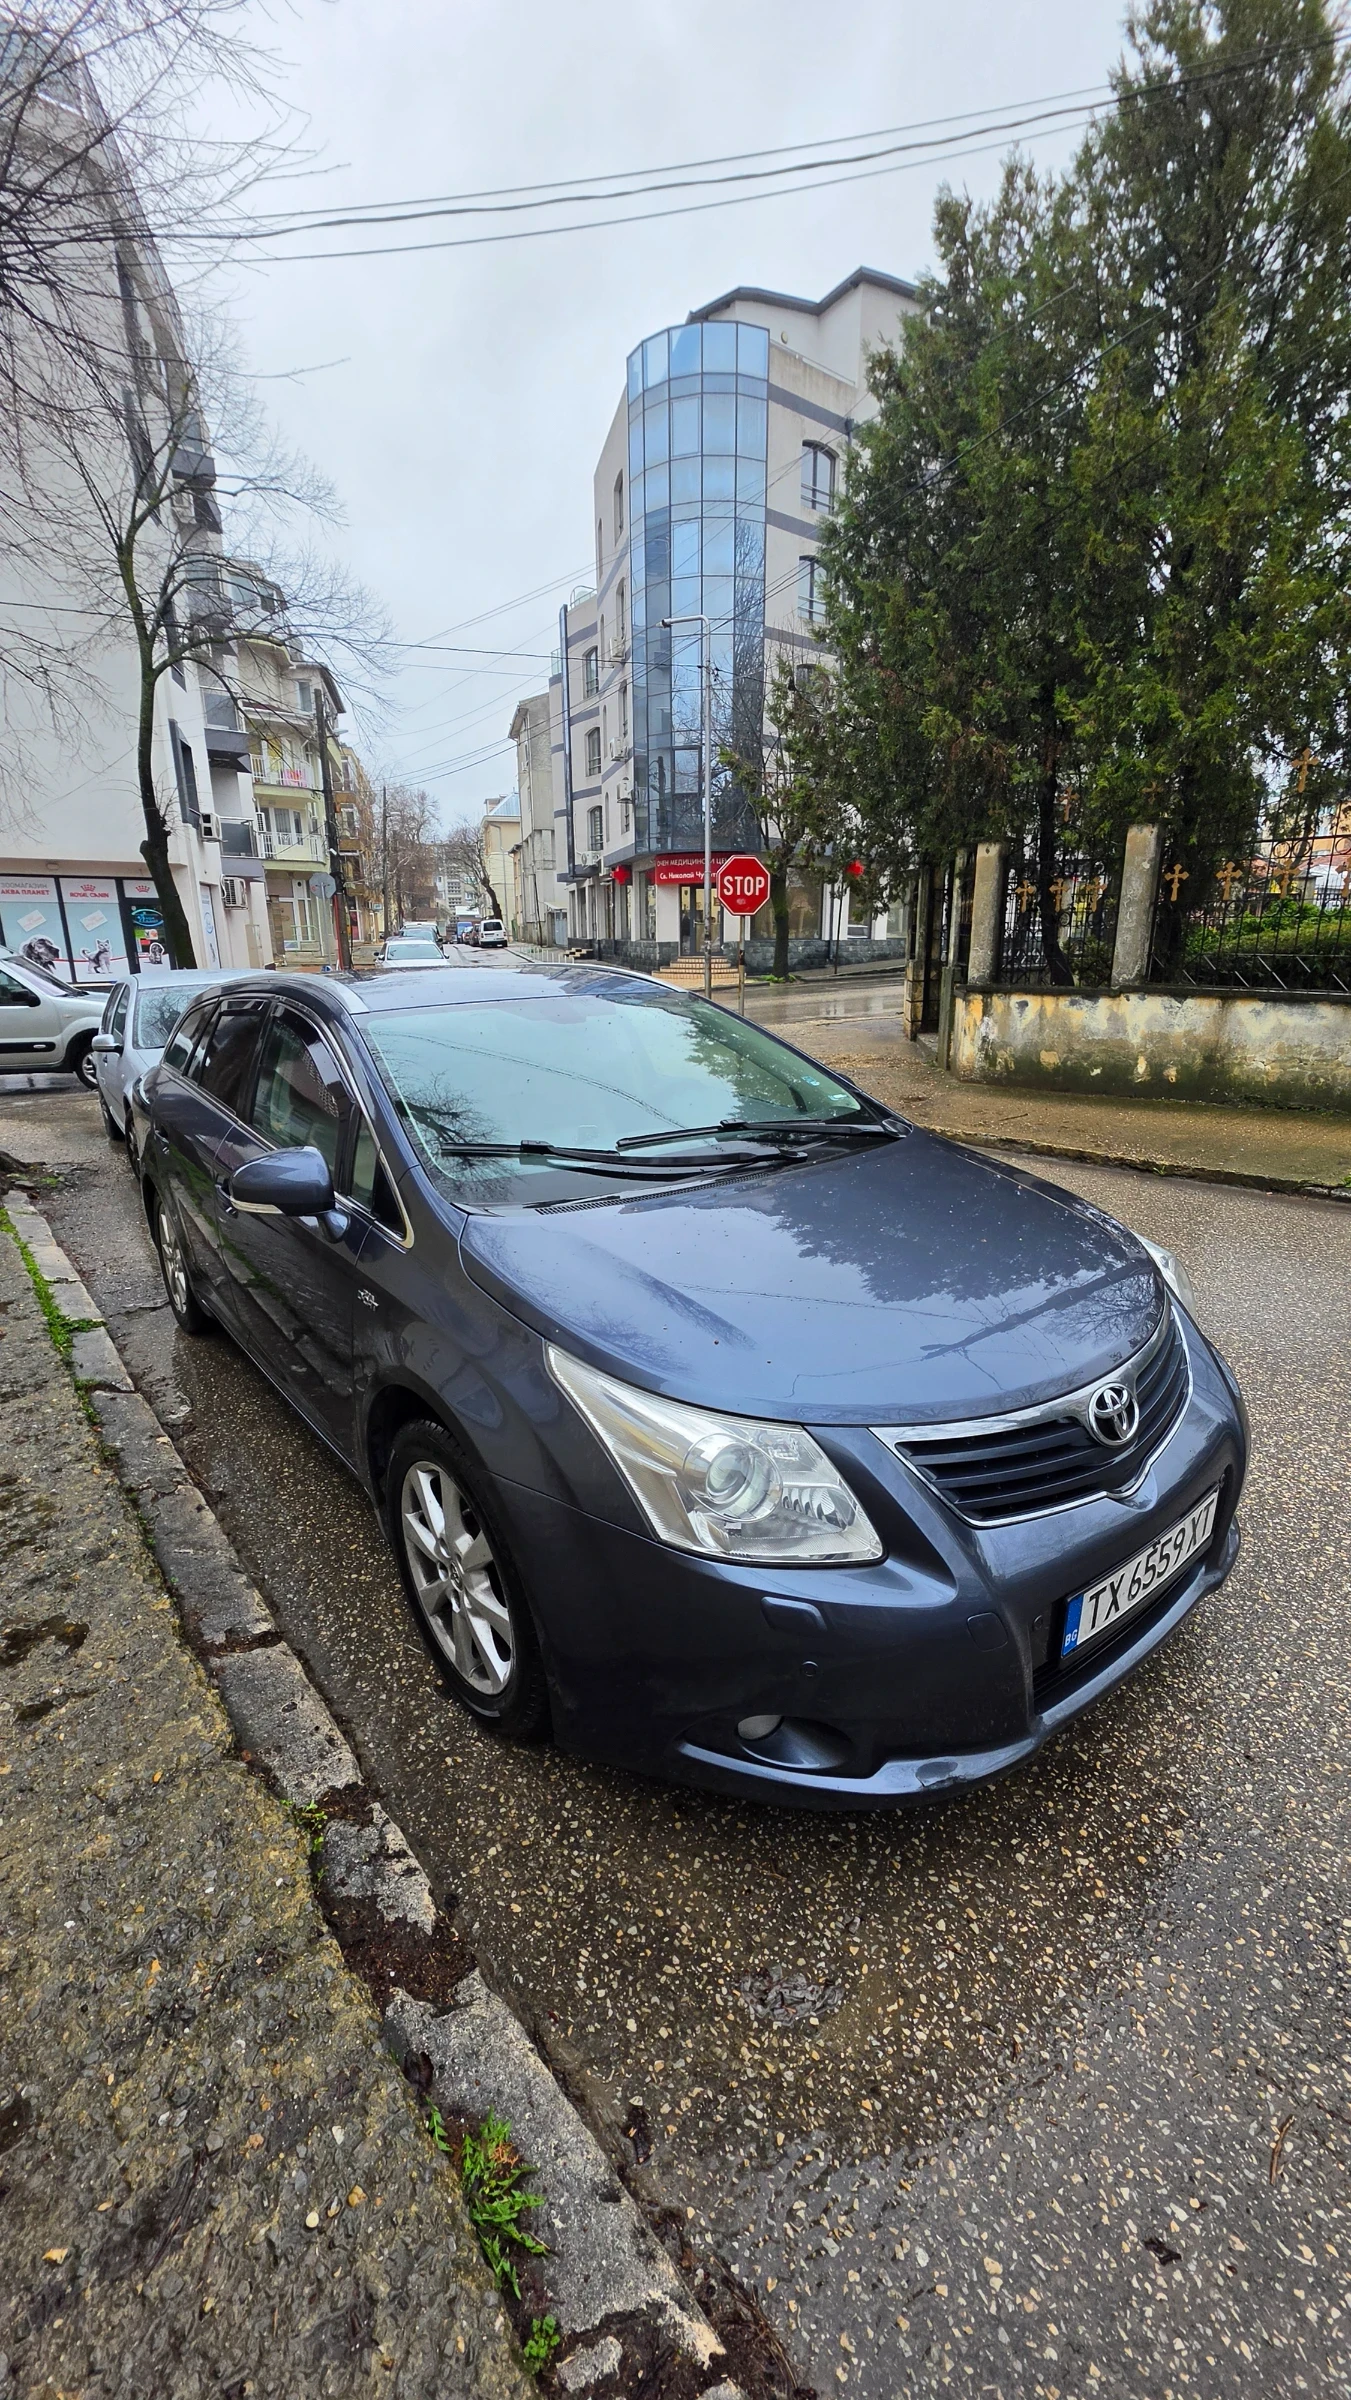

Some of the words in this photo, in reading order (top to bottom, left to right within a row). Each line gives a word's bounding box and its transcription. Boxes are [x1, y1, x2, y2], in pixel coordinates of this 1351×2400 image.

[670, 858, 715, 866] МЕДИЦИНСИ
[723, 875, 765, 896] STOP
[1088, 1573, 1125, 1629] TX
[1127, 1527, 1186, 1602] 6559
[1064, 1629, 1078, 1647] BG
